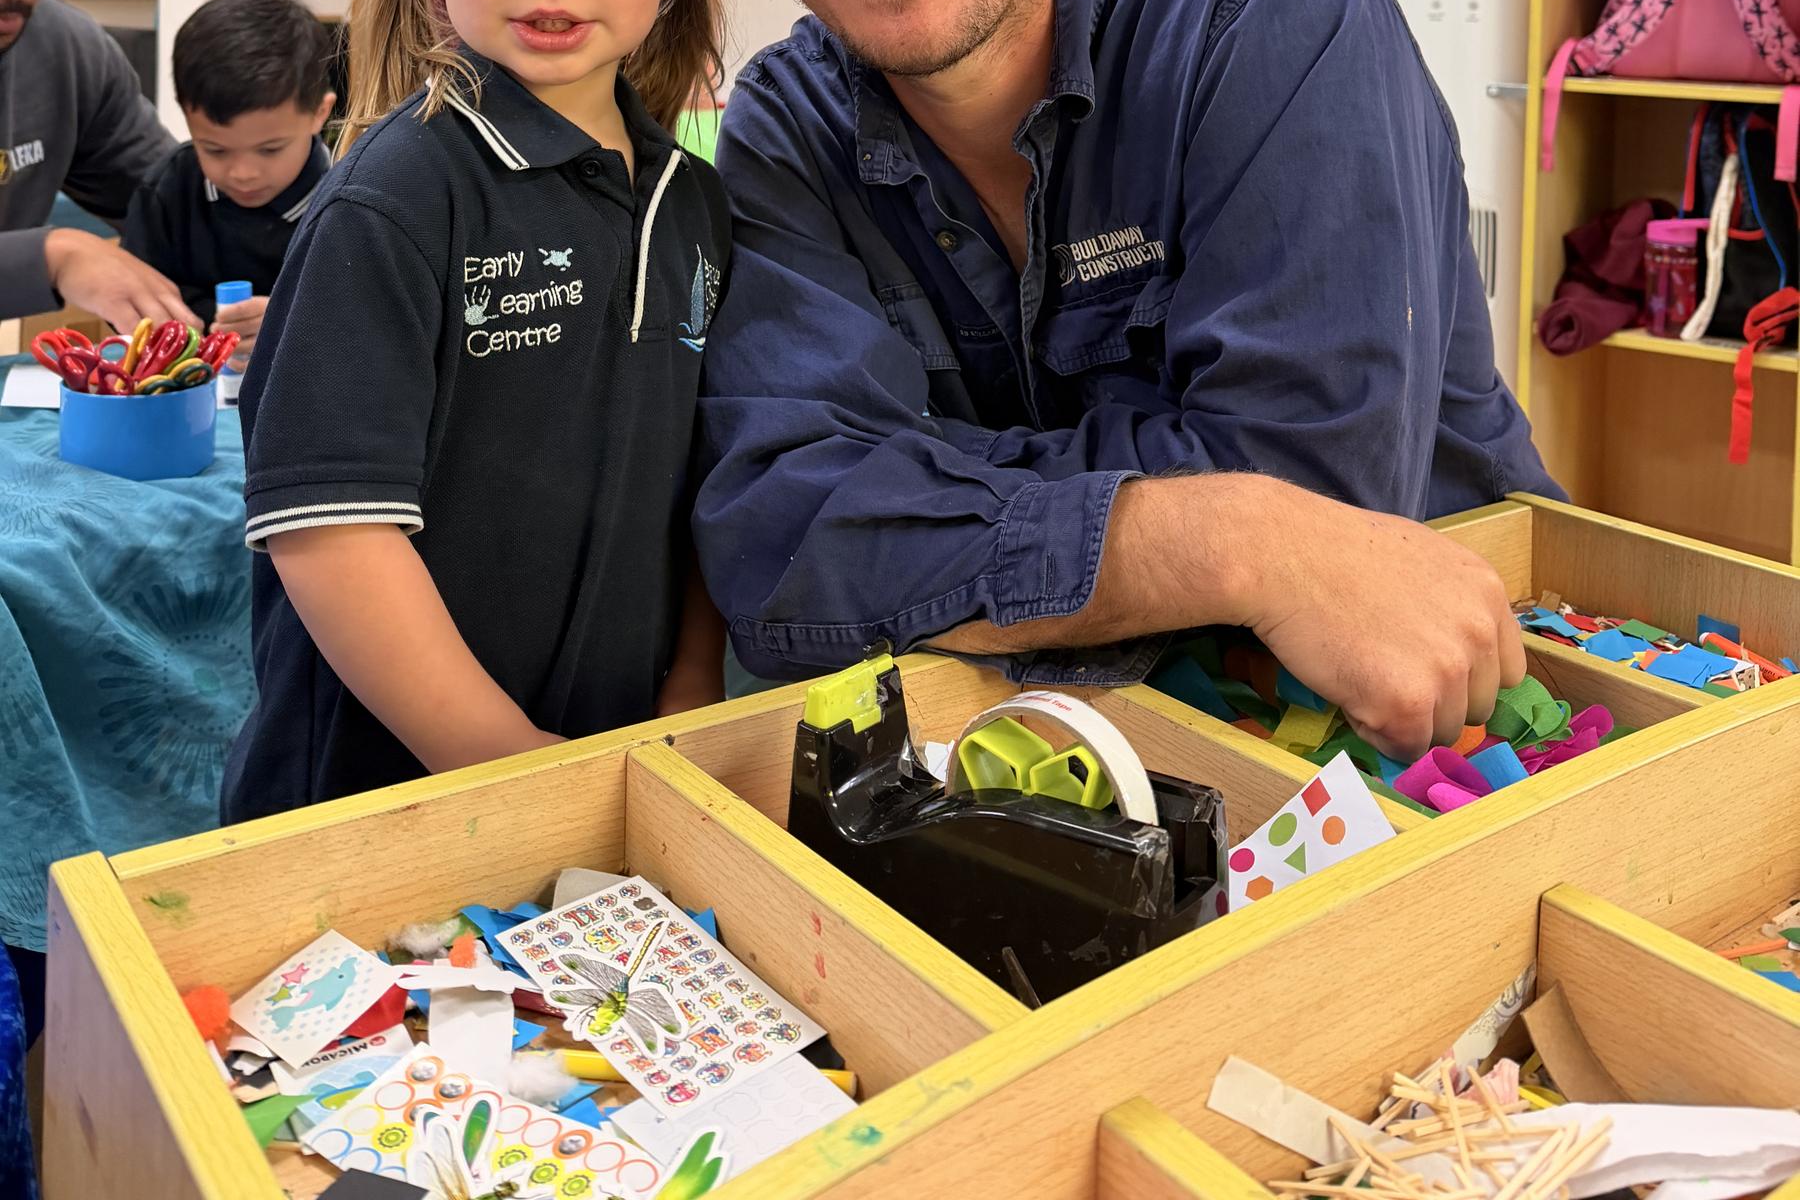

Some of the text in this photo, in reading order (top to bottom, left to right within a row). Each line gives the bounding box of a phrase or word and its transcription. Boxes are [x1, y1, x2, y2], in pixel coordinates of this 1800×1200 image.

[1069, 225, 1145, 262] BUILDAWAY
[463, 250, 524, 284] Early
[466, 322, 562, 358] Centre
